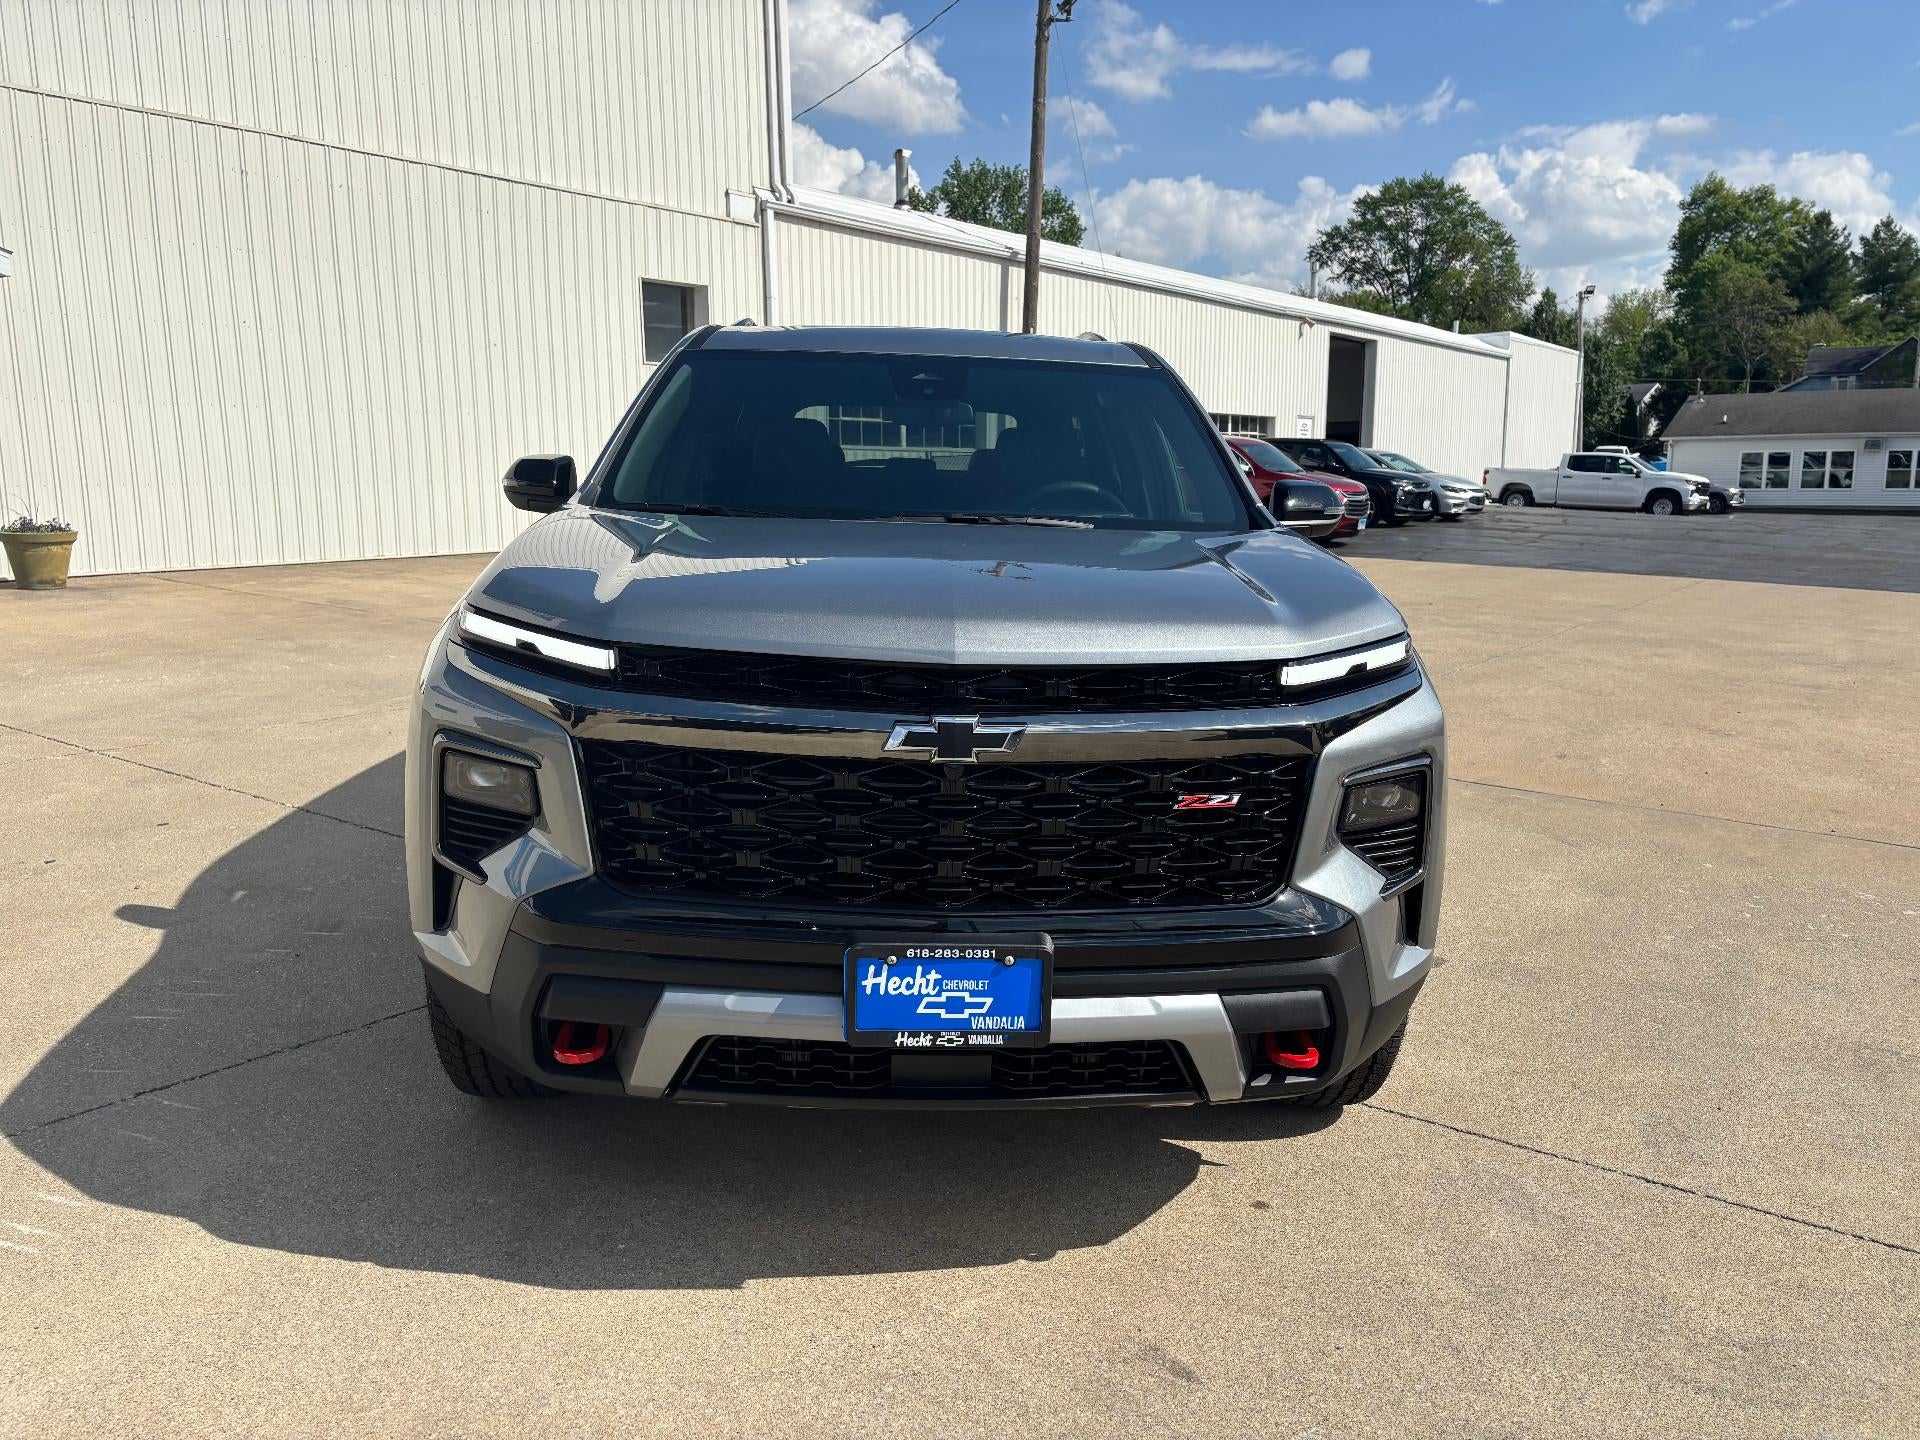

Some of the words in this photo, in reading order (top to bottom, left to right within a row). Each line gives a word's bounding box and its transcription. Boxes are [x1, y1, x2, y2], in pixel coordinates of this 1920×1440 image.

[1173, 794, 1241, 809] Z71
[906, 949, 996, 958] 618-283-0381
[862, 964, 942, 995] Hecht
[942, 980, 989, 990] CHEVROLET
[971, 1016, 1025, 1029] VANDALIA
[895, 1032, 933, 1046] Hecht
[968, 1035, 1003, 1045] VANDALIA
